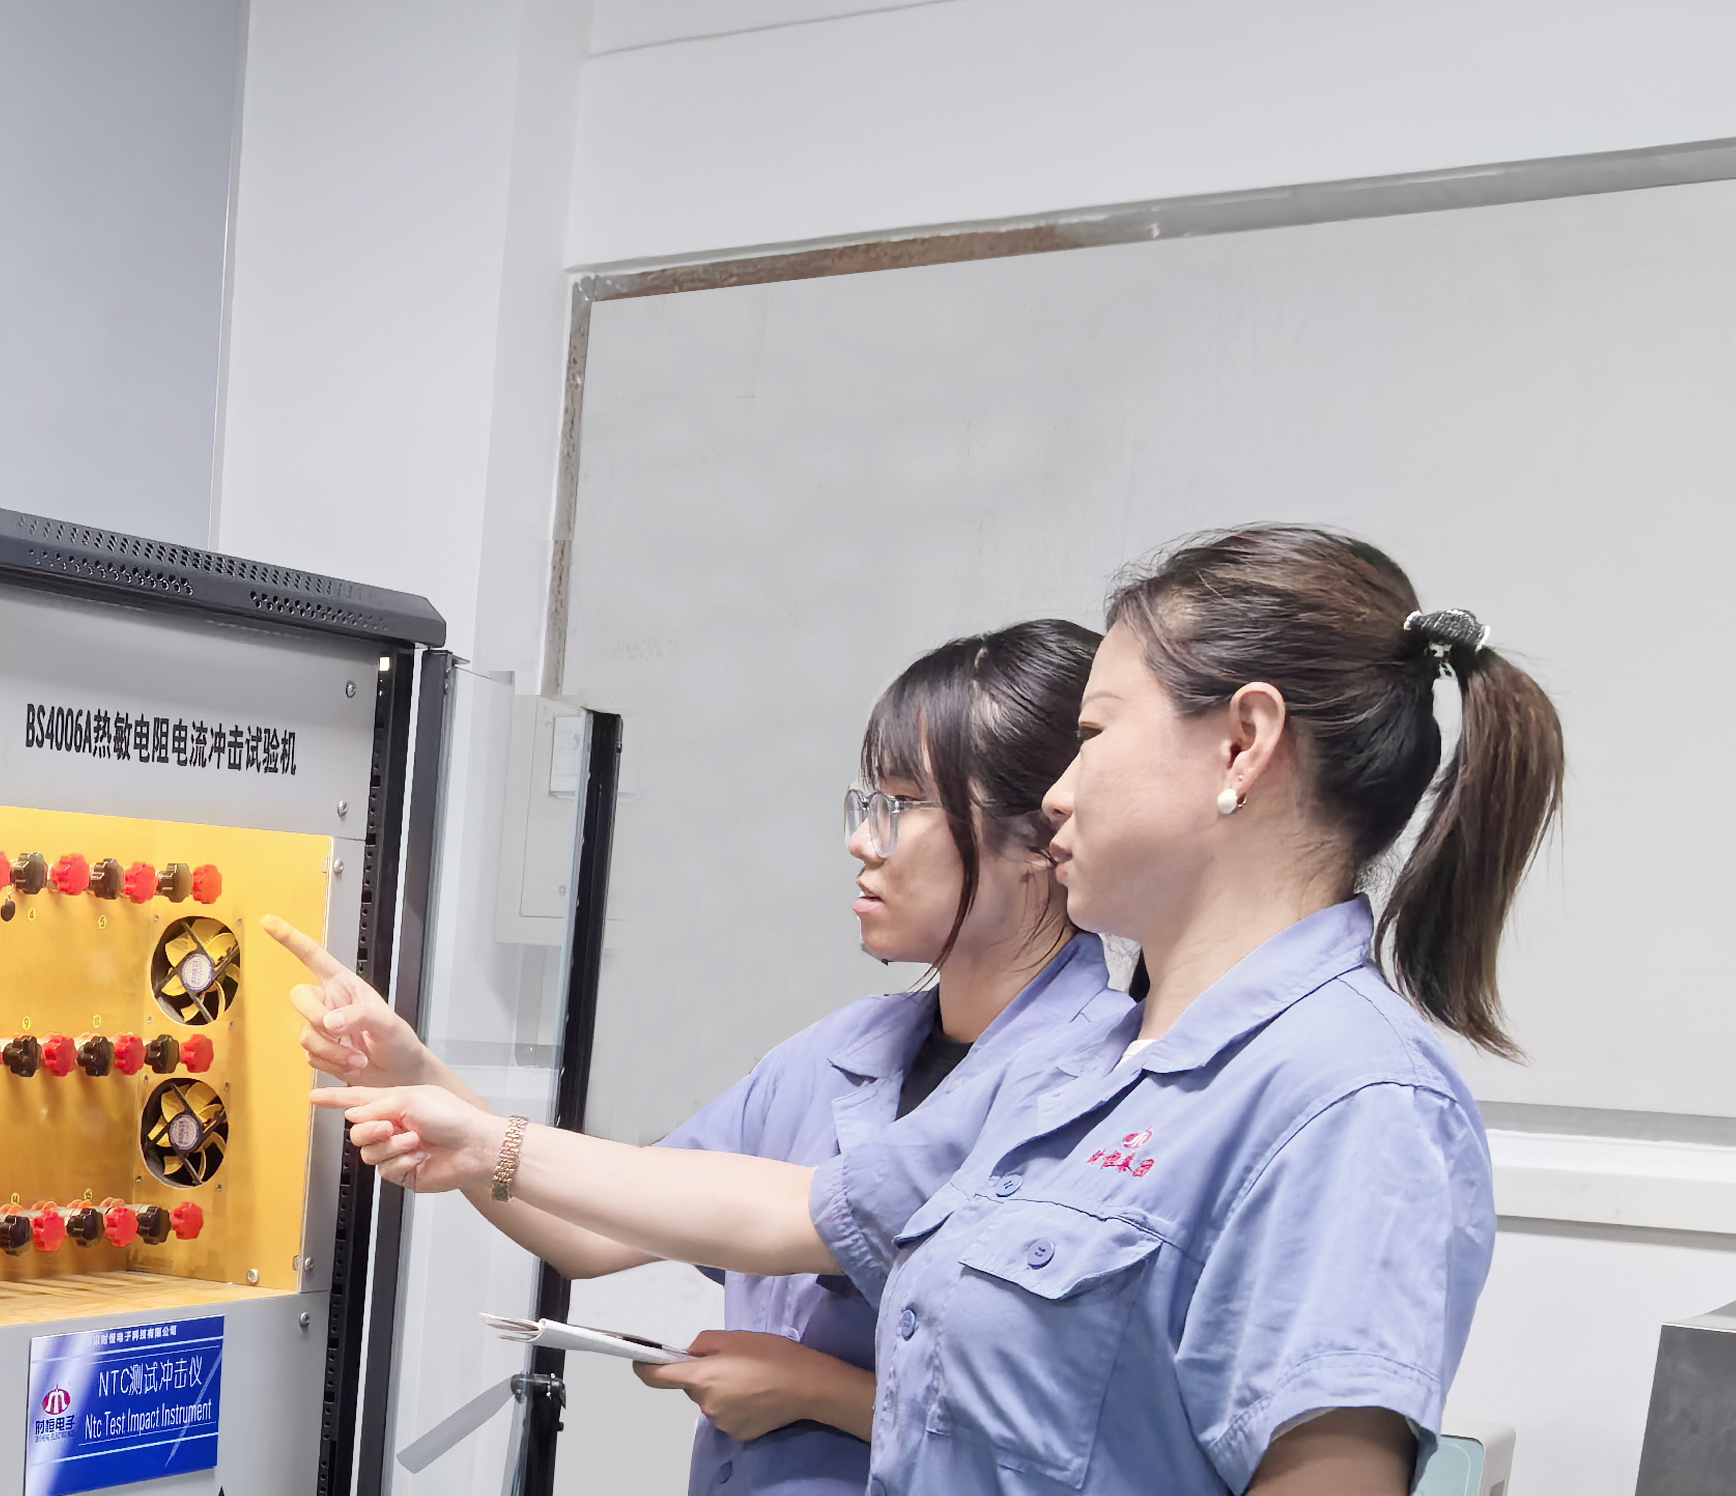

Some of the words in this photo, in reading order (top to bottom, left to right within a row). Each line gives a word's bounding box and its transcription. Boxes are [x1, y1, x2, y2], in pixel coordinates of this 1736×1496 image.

[25, 703, 297, 776] BS4006A热敏电阻电流冲击试验机
[98, 1355, 203, 1397] NTC测试冲击仪
[35, 1415, 75, 1435] 时恒电子
[85, 1414, 102, 1440] Ntc
[104, 1411, 125, 1436] Test
[127, 1407, 160, 1435] Impact
[162, 1398, 212, 1427] Instrument
